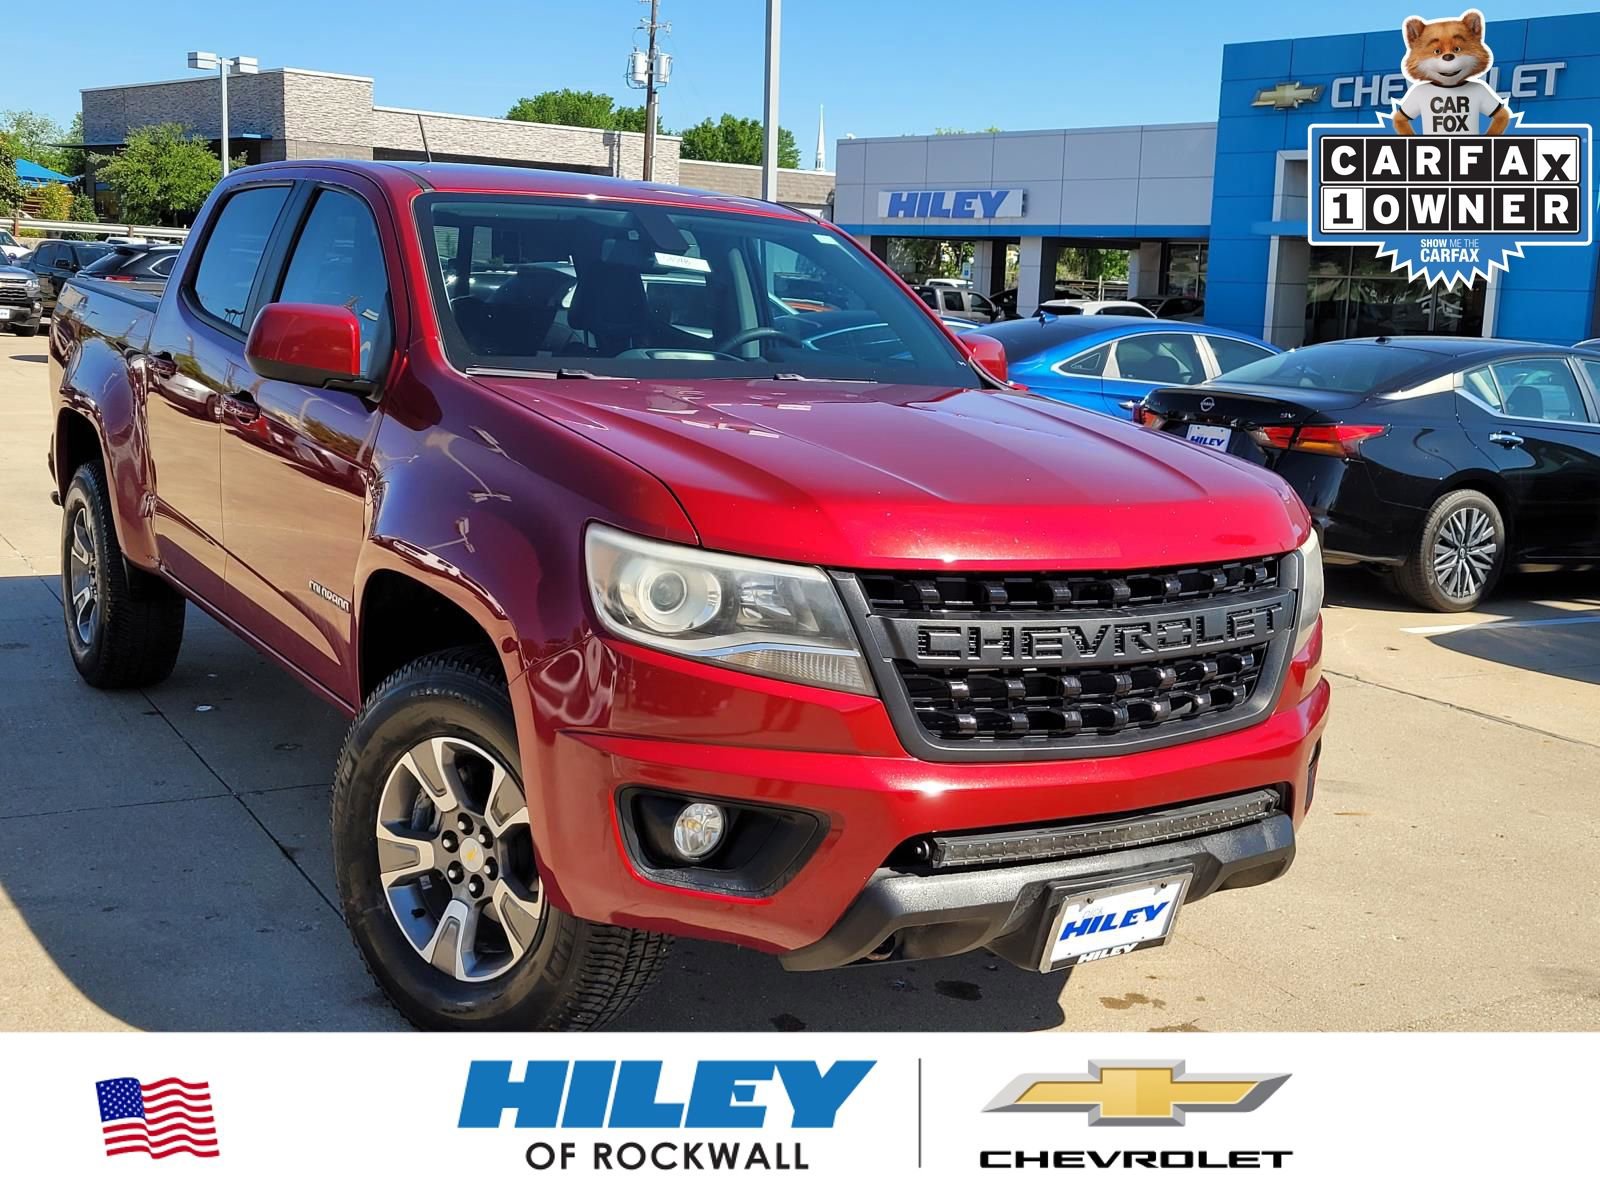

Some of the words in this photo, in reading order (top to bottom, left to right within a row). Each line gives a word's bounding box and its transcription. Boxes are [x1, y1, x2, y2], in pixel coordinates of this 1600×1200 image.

[1331, 62, 1566, 109] CHELET
[888, 190, 1009, 218] HILEY
[1190, 436, 1225, 447] HILEY
[917, 602, 1282, 660] CHEVROLET
[1059, 901, 1170, 941] HILEY
[1077, 942, 1139, 964] HILEY
